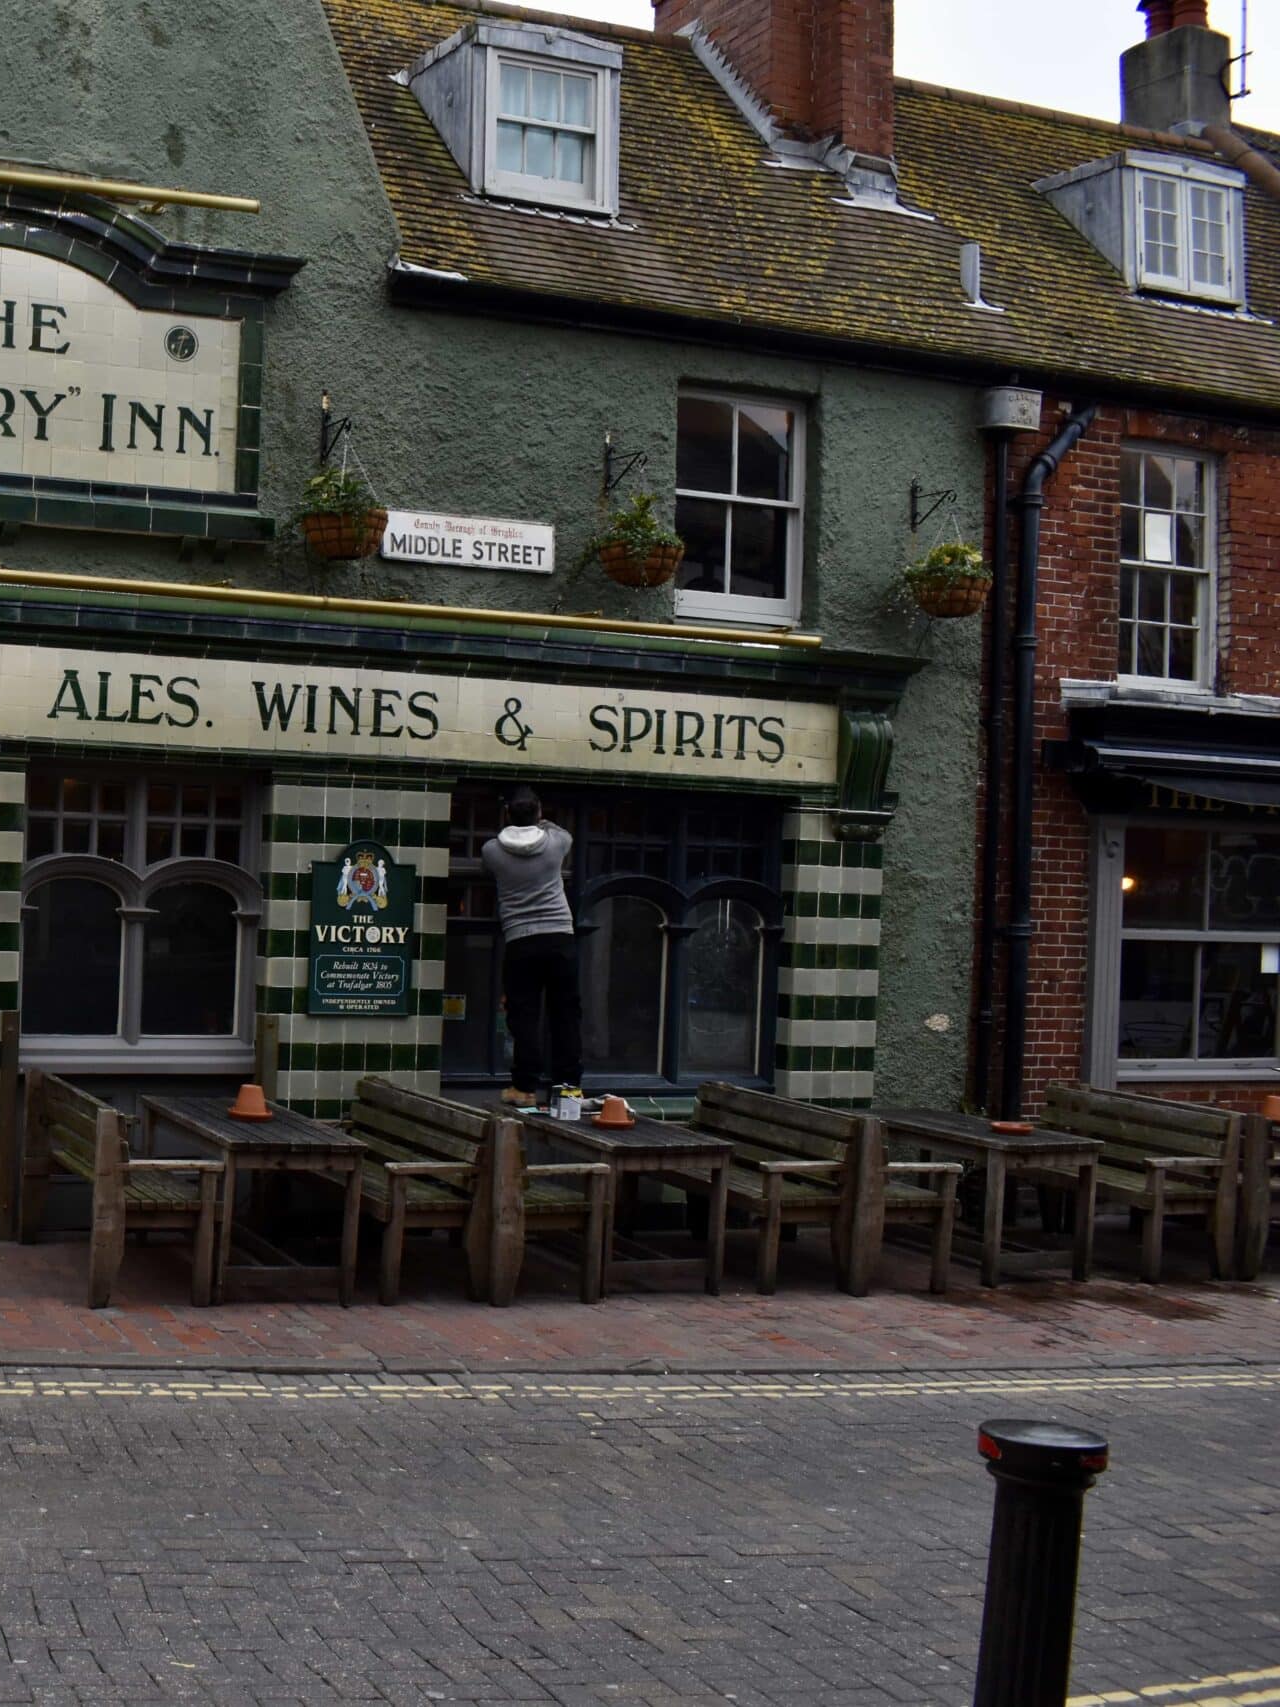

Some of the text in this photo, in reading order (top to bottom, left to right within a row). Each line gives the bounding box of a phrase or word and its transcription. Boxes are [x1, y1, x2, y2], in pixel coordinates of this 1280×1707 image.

[99, 392, 219, 457] INN.
[390, 533, 545, 566] MIDDLE STREET
[251, 679, 439, 741] WINES
[494, 697, 534, 751] &
[588, 704, 786, 764] SPIRITS
[352, 915, 374, 923] THE
[315, 925, 408, 943] VICTORY
[333, 961, 358, 969] Rebuilt
[373, 971, 400, 981] Victory
[338, 980, 373, 991] Trafalgar
